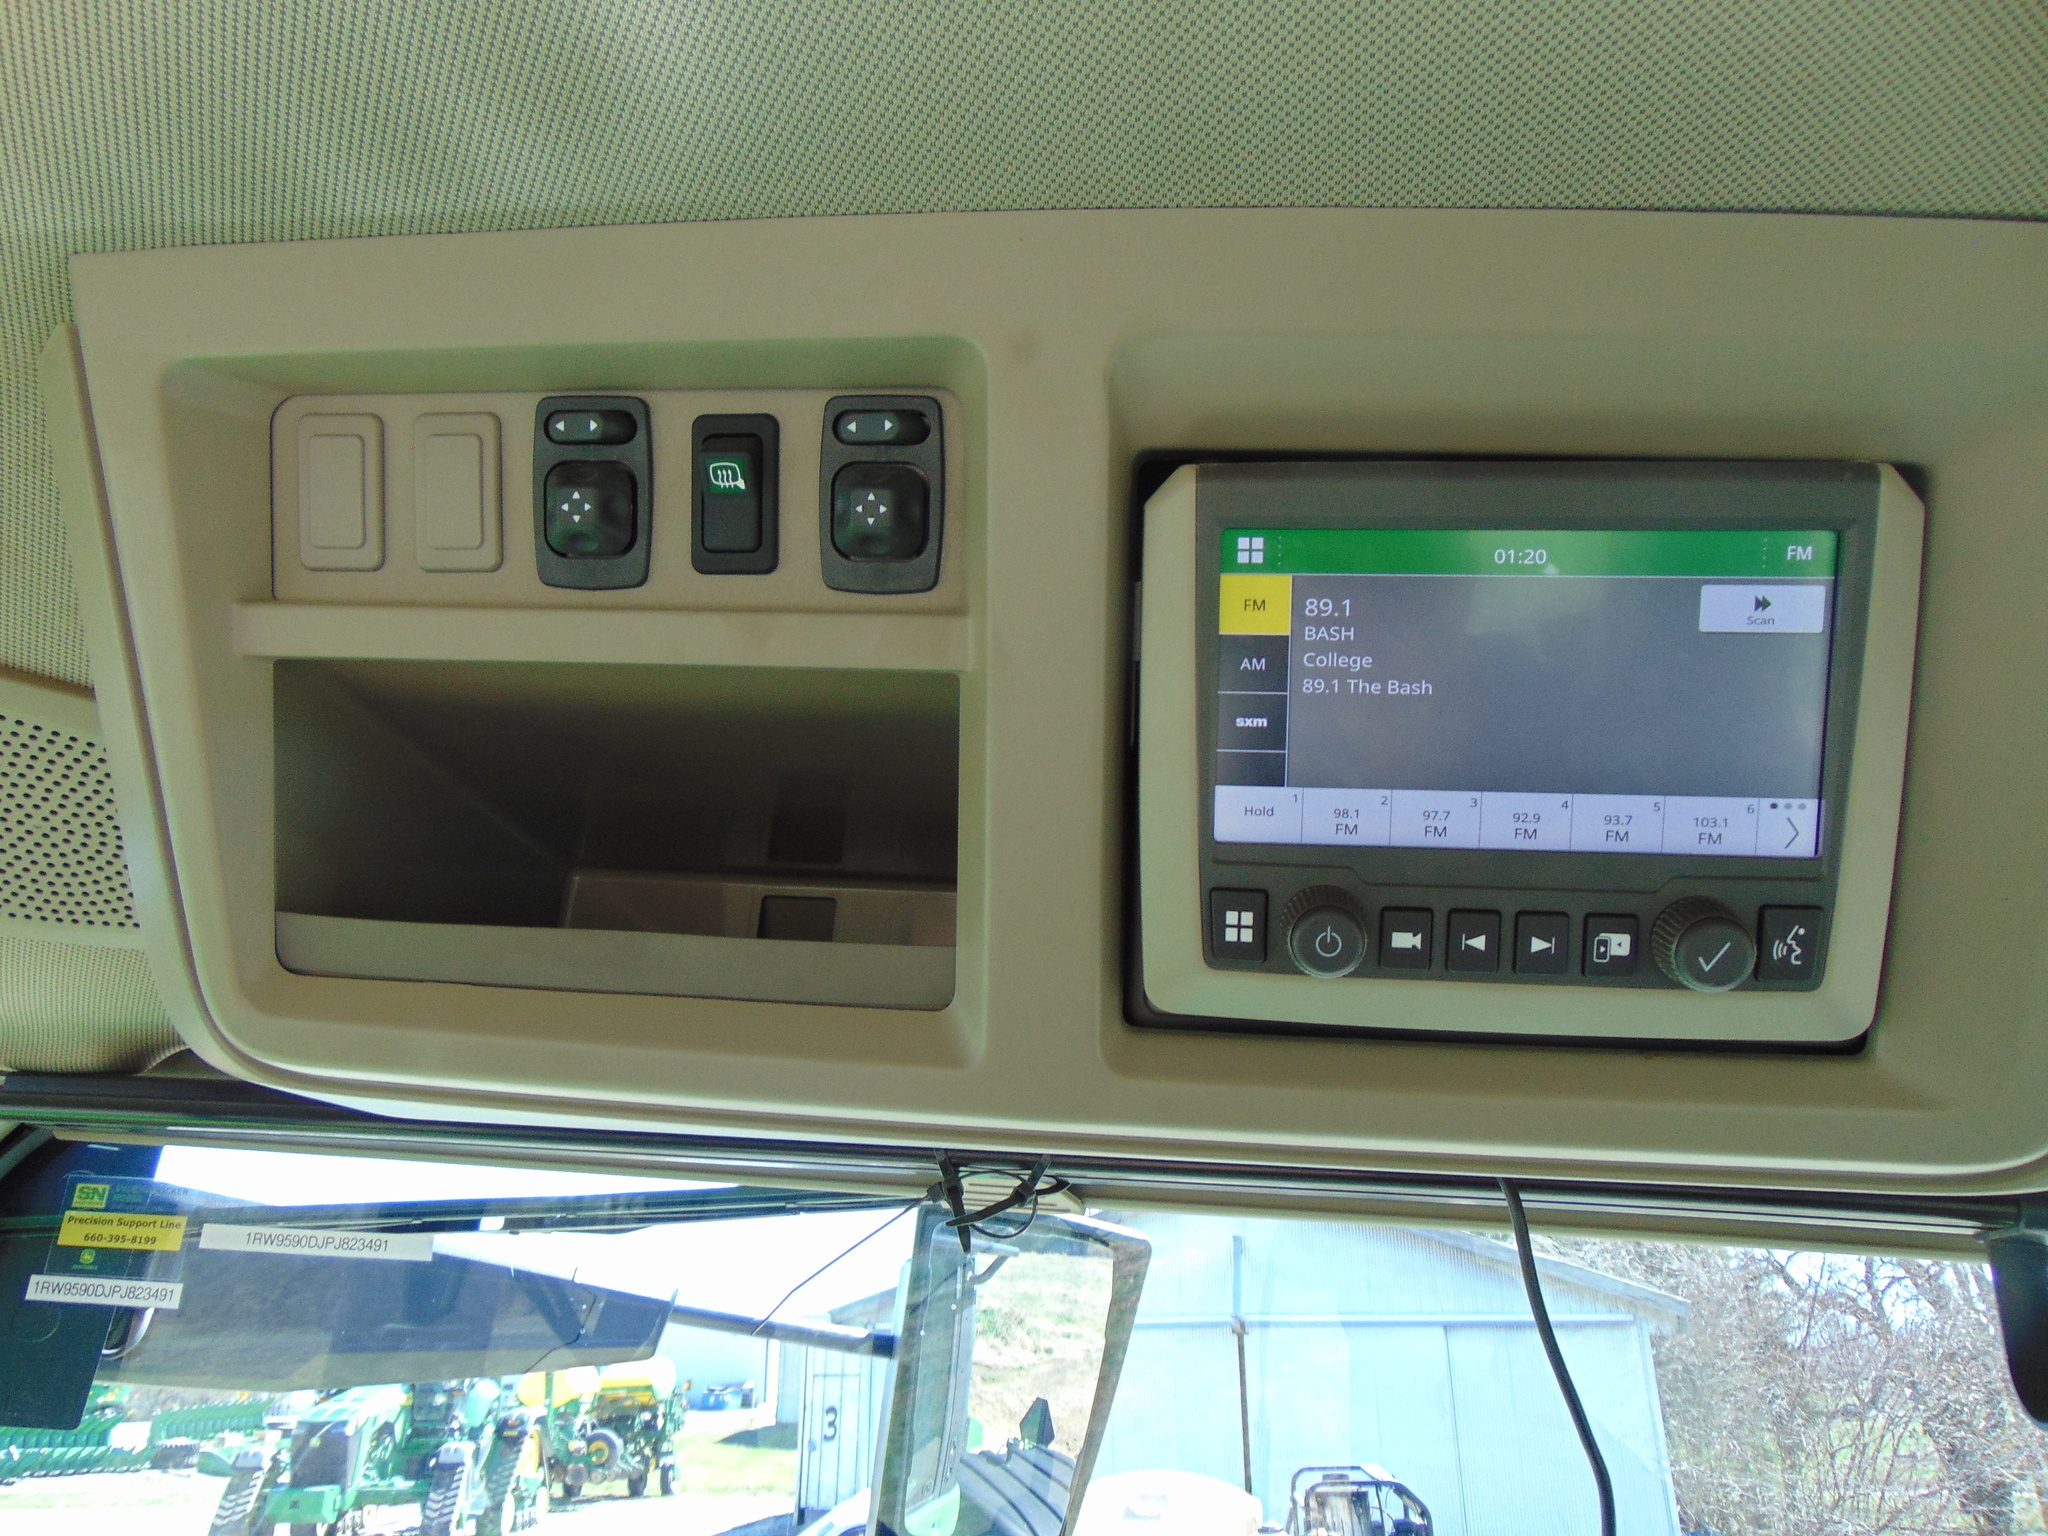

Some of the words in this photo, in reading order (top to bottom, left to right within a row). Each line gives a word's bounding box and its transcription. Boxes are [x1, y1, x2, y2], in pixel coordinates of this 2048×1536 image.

[1493, 548, 1547, 565] 01:20
[1786, 545, 1813, 561] FM
[1243, 597, 1267, 612] FM
[1304, 597, 1353, 617] 89.1
[1745, 614, 1775, 626] Scan
[1303, 625, 1356, 642] BASH
[1240, 656, 1266, 672] AM
[1302, 651, 1373, 672] College
[1302, 678, 1340, 694] 89.1
[1346, 678, 1382, 695] The
[1387, 678, 1433, 695] Bash
[1235, 715, 1268, 728] sxm
[1292, 794, 1298, 803] 1
[1380, 796, 1388, 806] 2
[1470, 797, 1478, 808] 3
[1560, 799, 1569, 810] 4
[1244, 804, 1275, 817] Hold
[1333, 807, 1361, 820] 98.1
[1653, 802, 1661, 812] 5
[1746, 804, 1755, 814] 6
[1422, 809, 1451, 822] 97.7
[1512, 811, 1541, 824] 92.9
[1603, 814, 1632, 827] 93.7
[1335, 822, 1359, 836] FM
[1693, 816, 1729, 829] 103.1
[1424, 824, 1448, 838] FM
[1514, 827, 1538, 840] FM
[1605, 829, 1629, 843] FM
[1698, 832, 1722, 845] FM
[66, 1215, 114, 1229] Precision
[116, 1218, 157, 1231] Support
[158, 1219, 182, 1230] Line
[83, 1231, 158, 1246] 660-395-8199
[245, 1231, 390, 1253] 1RW9590DJPJ823491
[33, 1280, 176, 1303] 1RW9590DJPJ823491
[823, 1406, 838, 1443] 3
